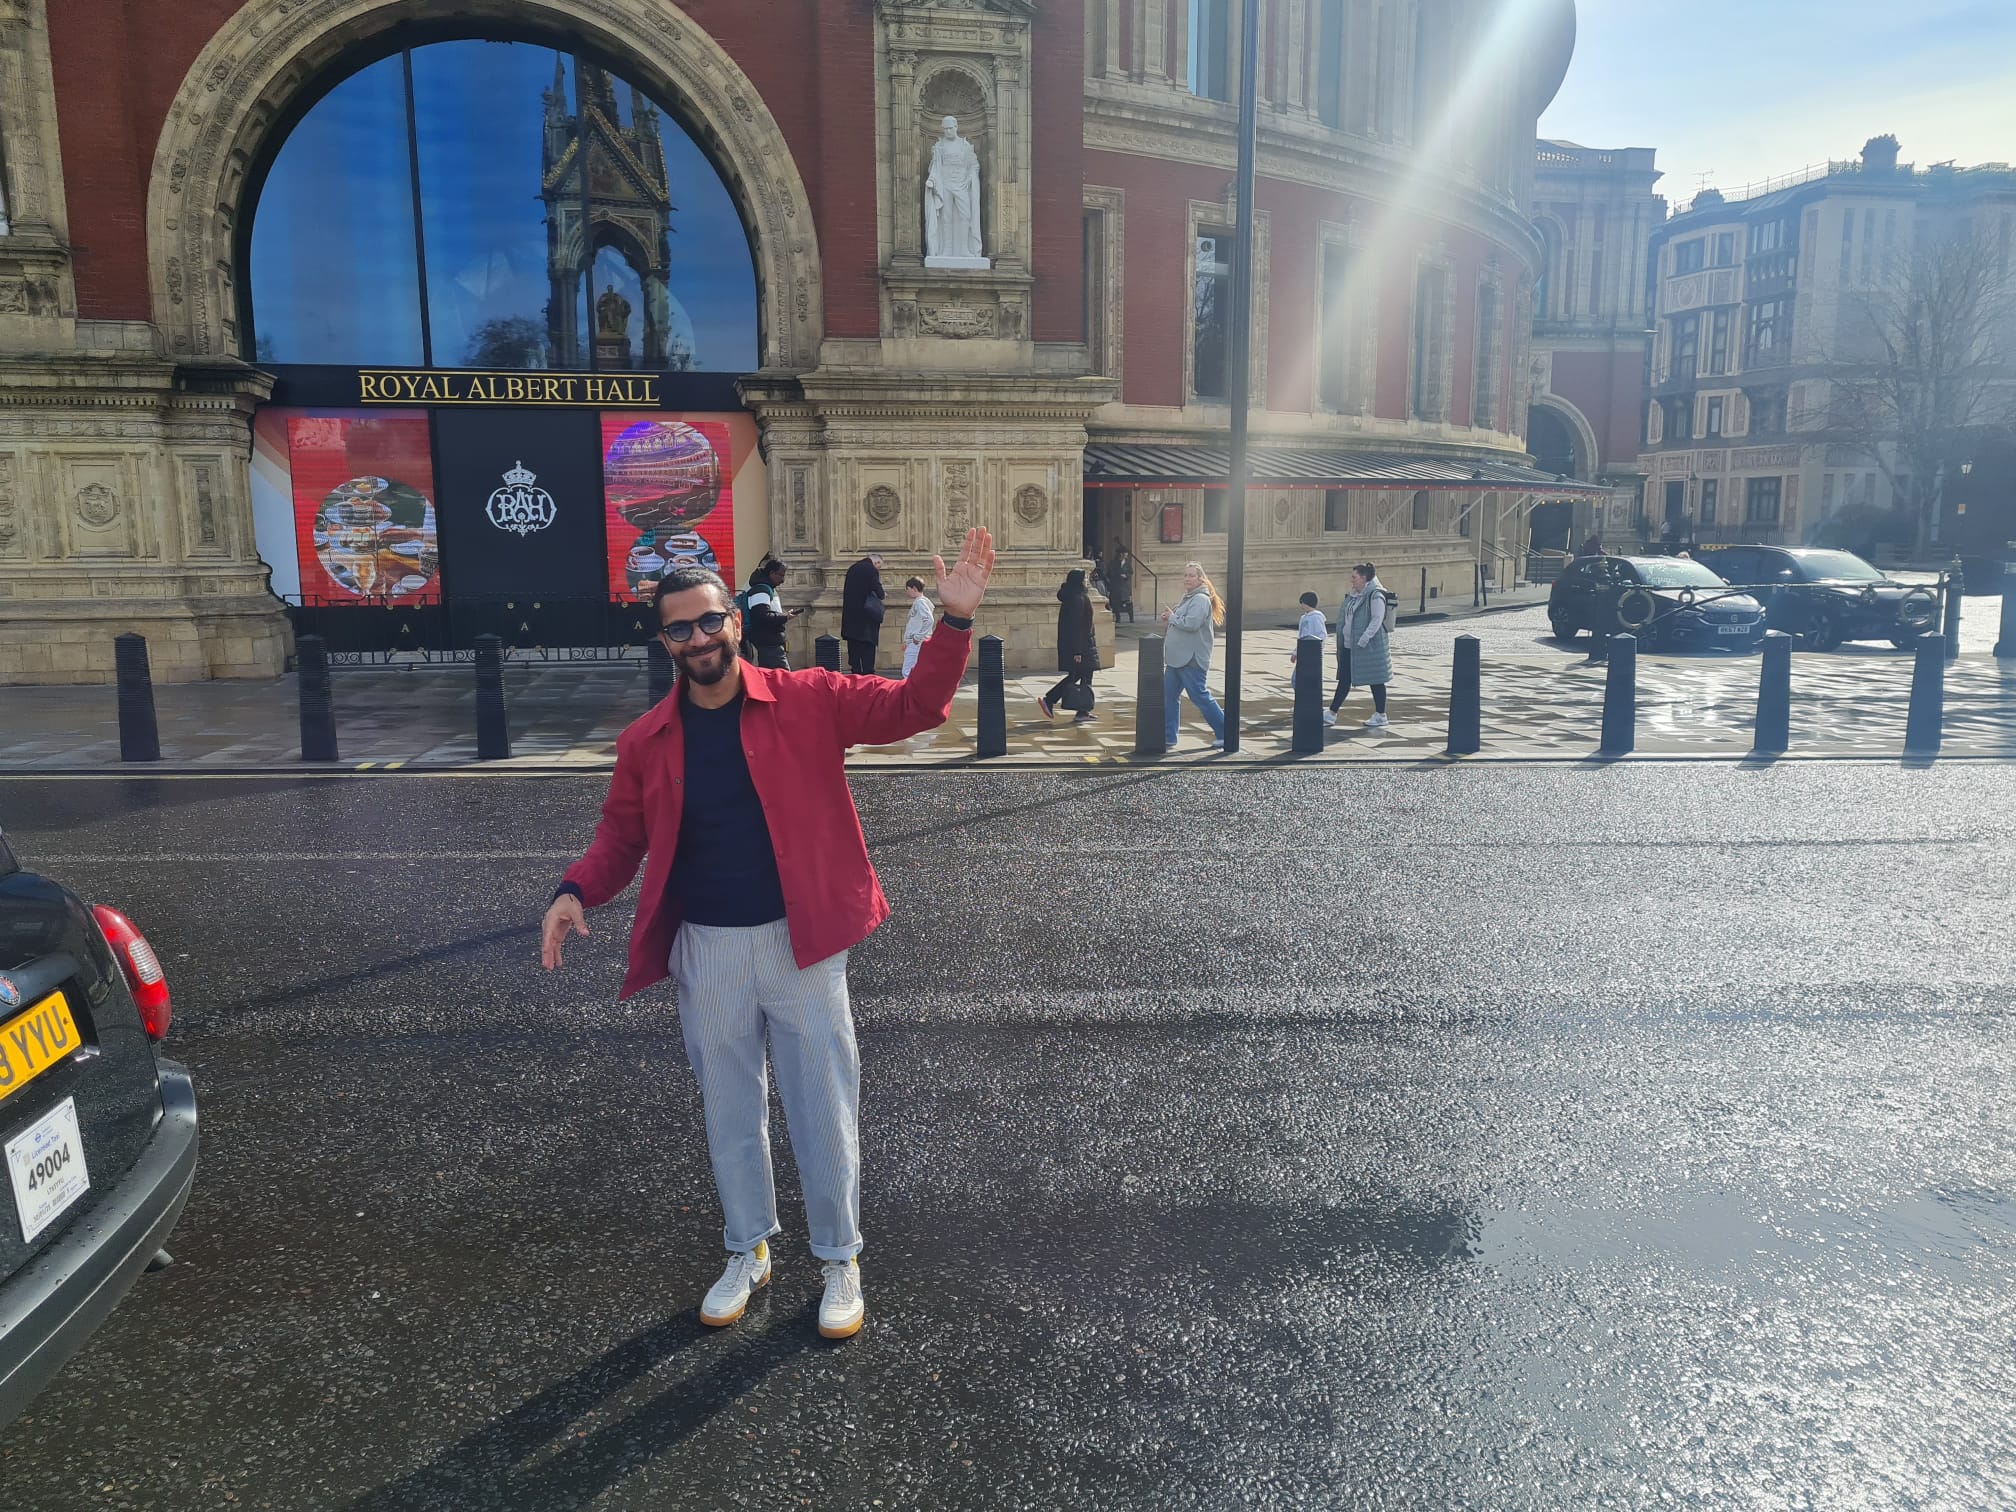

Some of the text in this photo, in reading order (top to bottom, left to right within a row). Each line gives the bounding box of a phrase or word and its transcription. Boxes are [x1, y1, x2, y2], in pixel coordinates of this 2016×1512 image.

[359, 375, 660, 402] ROYAL ALBERT HALL
[401, 624, 410, 633] A
[520, 622, 529, 631] A
[9, 1005, 67, 1070] YYU
[29, 1142, 71, 1191] 49004
